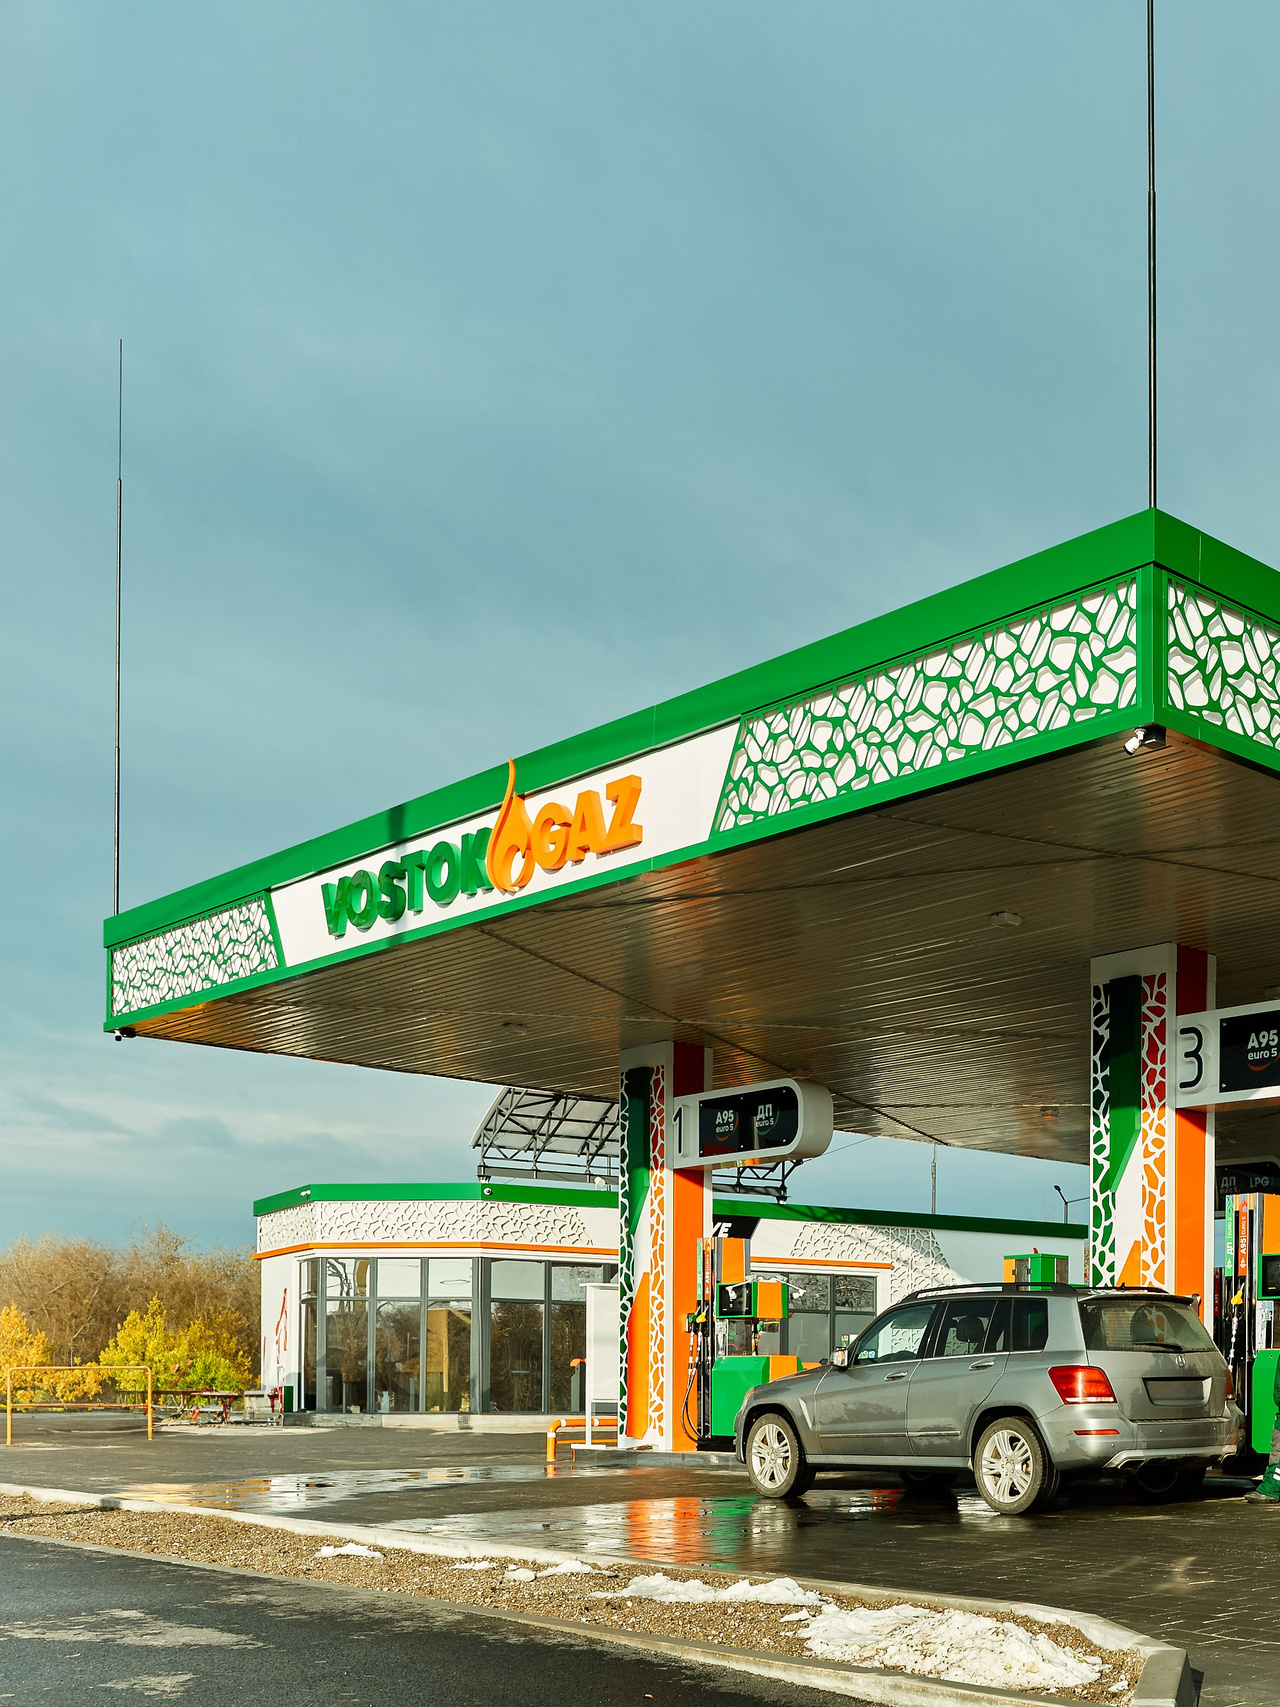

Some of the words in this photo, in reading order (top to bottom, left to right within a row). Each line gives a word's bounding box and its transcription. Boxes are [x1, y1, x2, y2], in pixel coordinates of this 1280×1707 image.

[321, 827, 495, 938] VOSTOK
[531, 774, 643, 872] GAZ
[1247, 1029, 1279, 1050] A95
[1179, 1026, 1204, 1089] 3
[1247, 1050, 1269, 1060] euro
[1271, 1047, 1278, 1057] 5
[715, 1110, 734, 1124] A95
[756, 1104, 773, 1120] ДП
[770, 1117, 775, 1126] 5
[673, 1106, 684, 1154] 1
[1250, 1176, 1269, 1188] LPG
